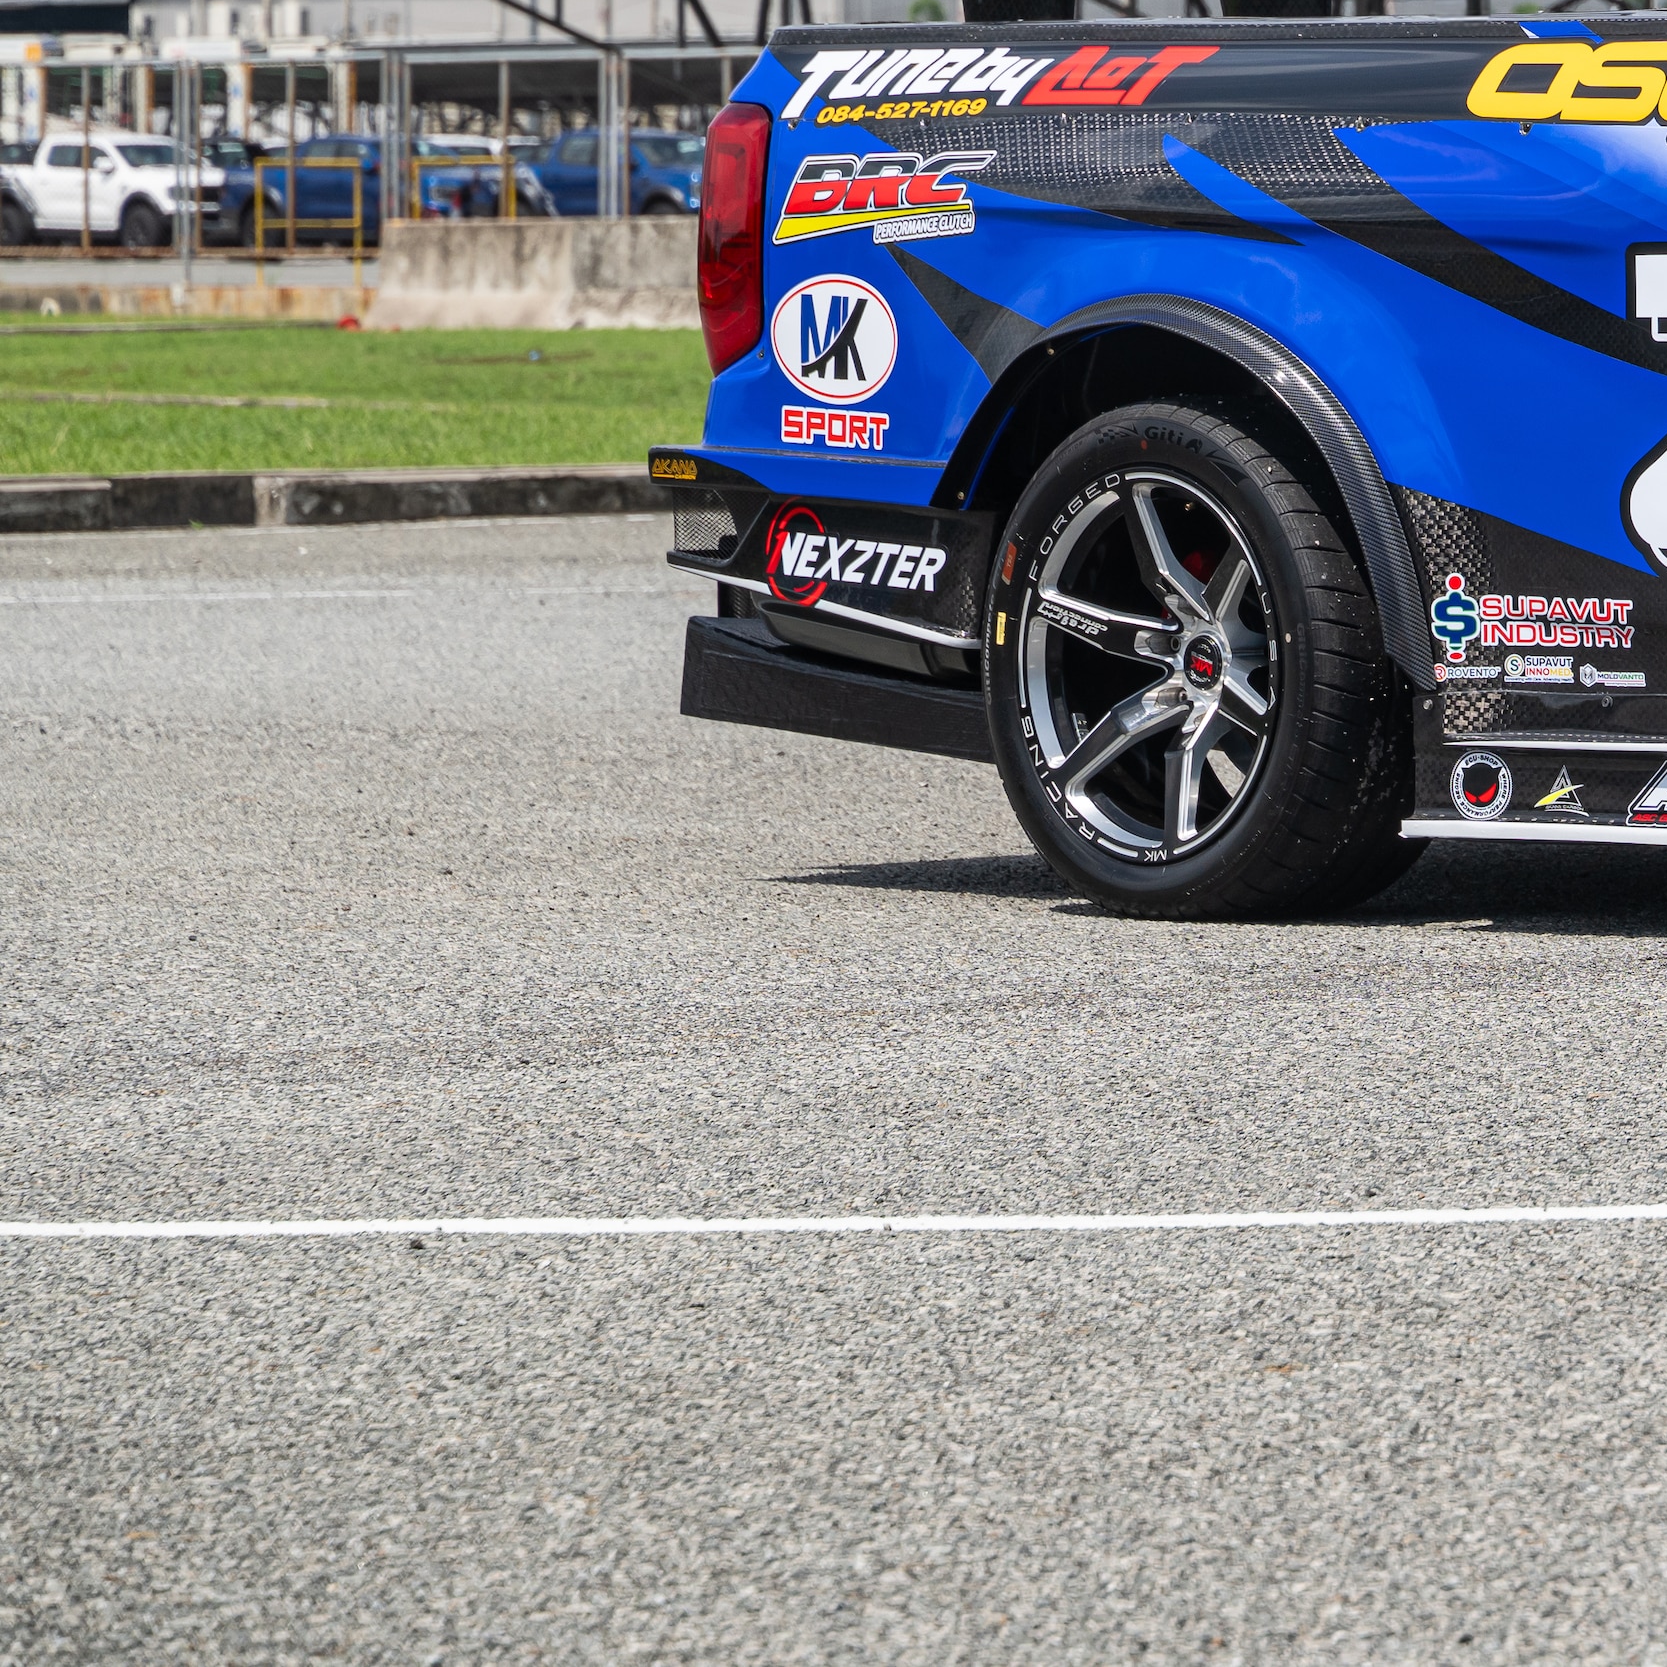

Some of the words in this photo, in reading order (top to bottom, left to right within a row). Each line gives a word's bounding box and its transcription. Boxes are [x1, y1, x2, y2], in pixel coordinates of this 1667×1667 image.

[816, 97, 988, 124] 084-527-1169
[784, 150, 998, 215] BRC
[874, 217, 938, 239] PERFORMANCE
[939, 212, 973, 231] CLUTCH
[801, 294, 868, 381] MK
[783, 407, 888, 449] SPORT
[1144, 425, 1185, 447] Giti
[1027, 471, 1122, 583] FORGED
[768, 531, 947, 592] NEXZTER
[1478, 594, 1634, 622] SUPAVUT
[1479, 622, 1635, 648] INDUSTRY
[1447, 667, 1498, 678] ROVENTO
[1525, 656, 1573, 667] SUPAVUT
[1020, 717, 1100, 841] RACING
[1632, 813, 1658, 822] ASC
[1142, 848, 1168, 863] MK
